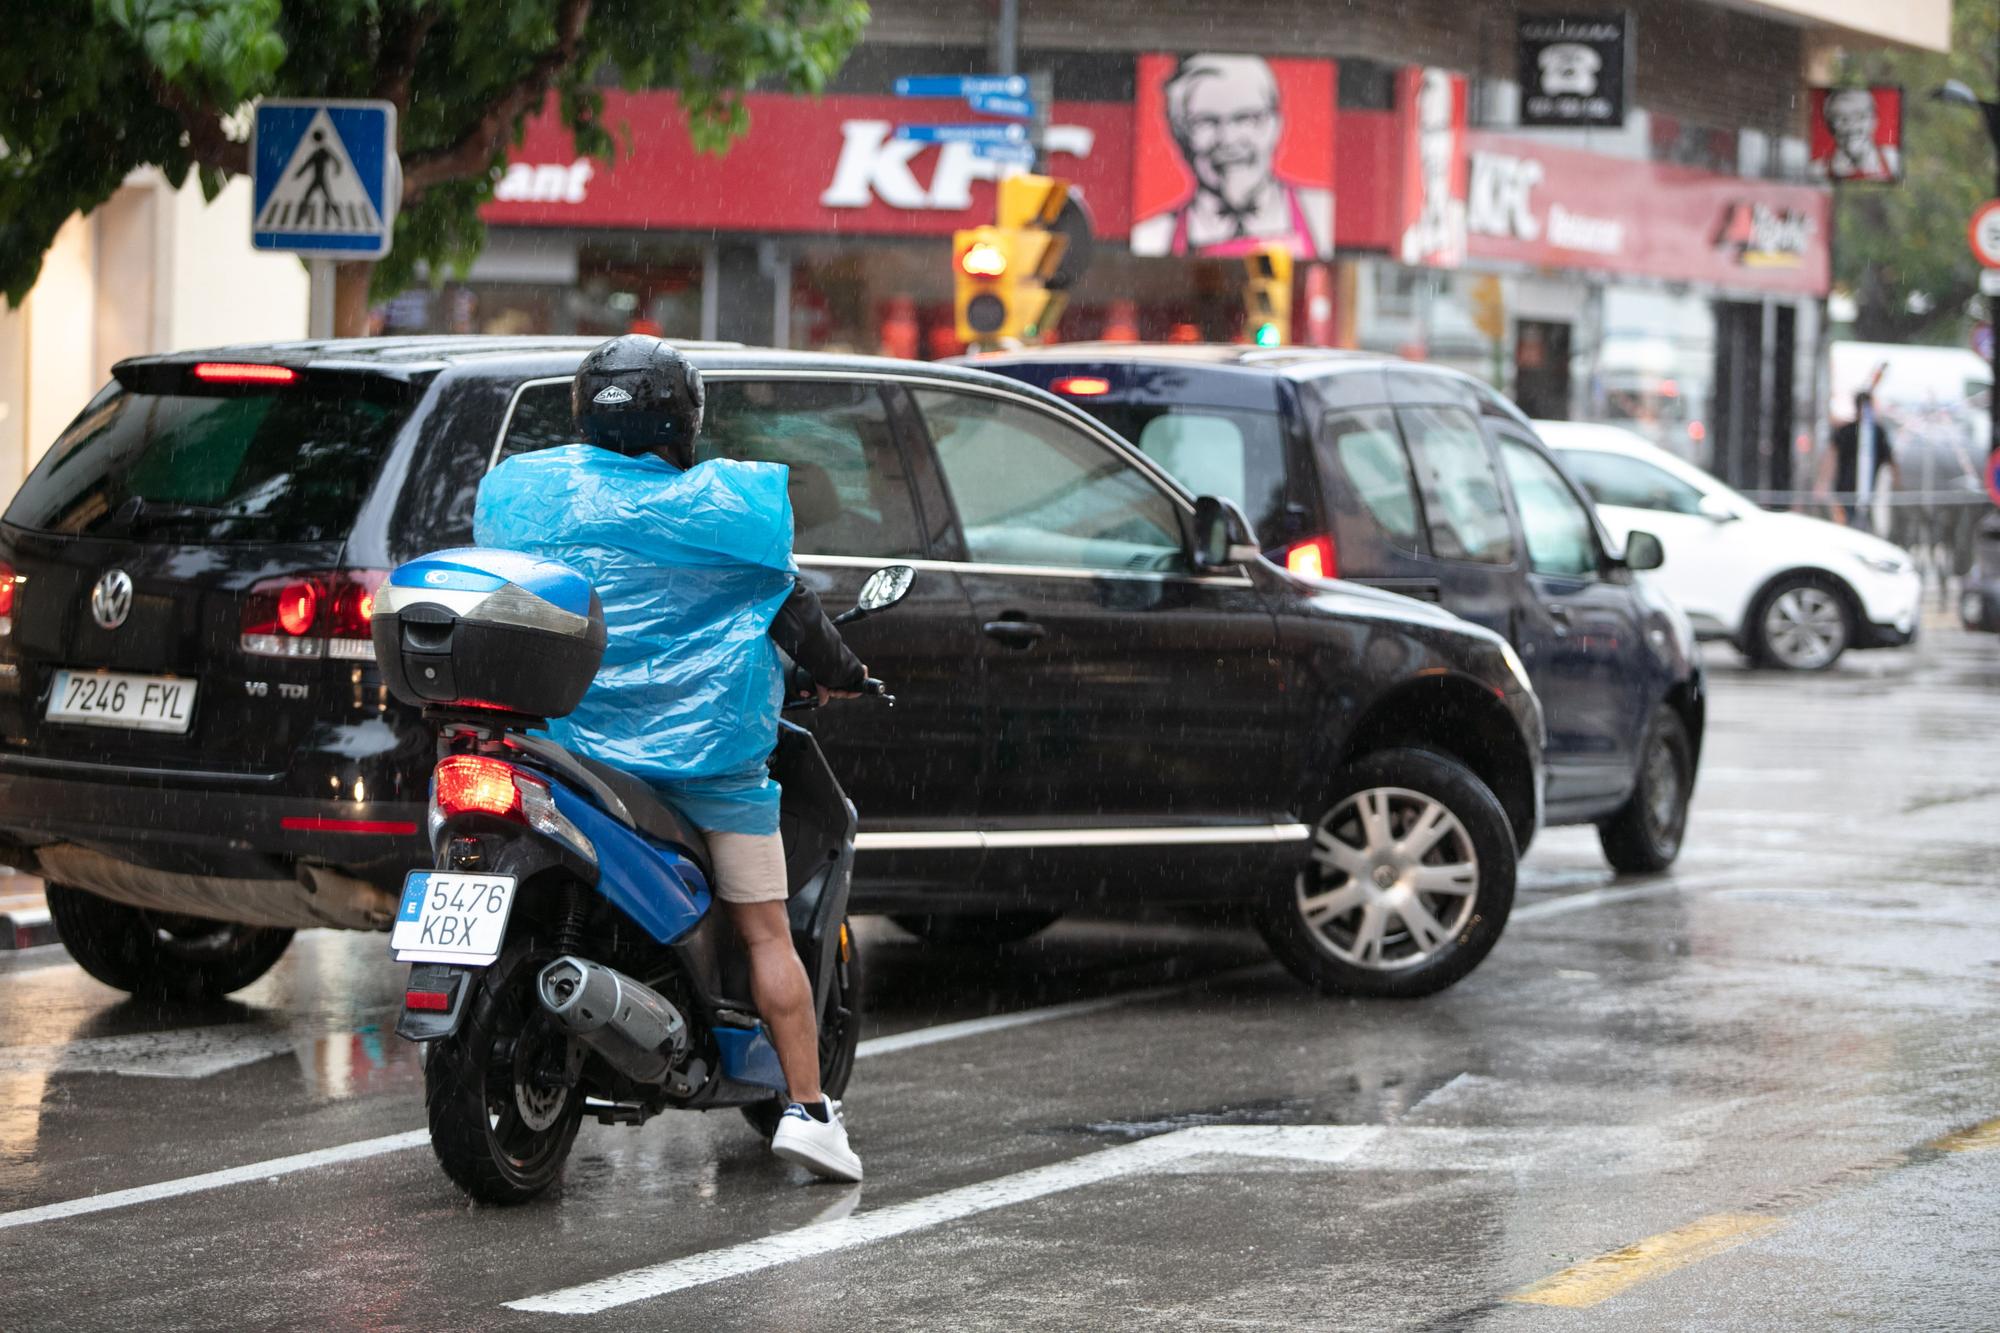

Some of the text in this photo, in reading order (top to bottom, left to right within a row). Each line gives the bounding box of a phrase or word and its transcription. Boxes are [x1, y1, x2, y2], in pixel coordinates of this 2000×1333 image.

[494, 157, 594, 204] ant
[600, 391, 623, 399] SMK
[65, 677, 183, 719] 7246 FYL
[245, 681, 268, 697] V6
[407, 902, 417, 913] E
[431, 881, 505, 914] 5476
[420, 915, 478, 947] KBX
